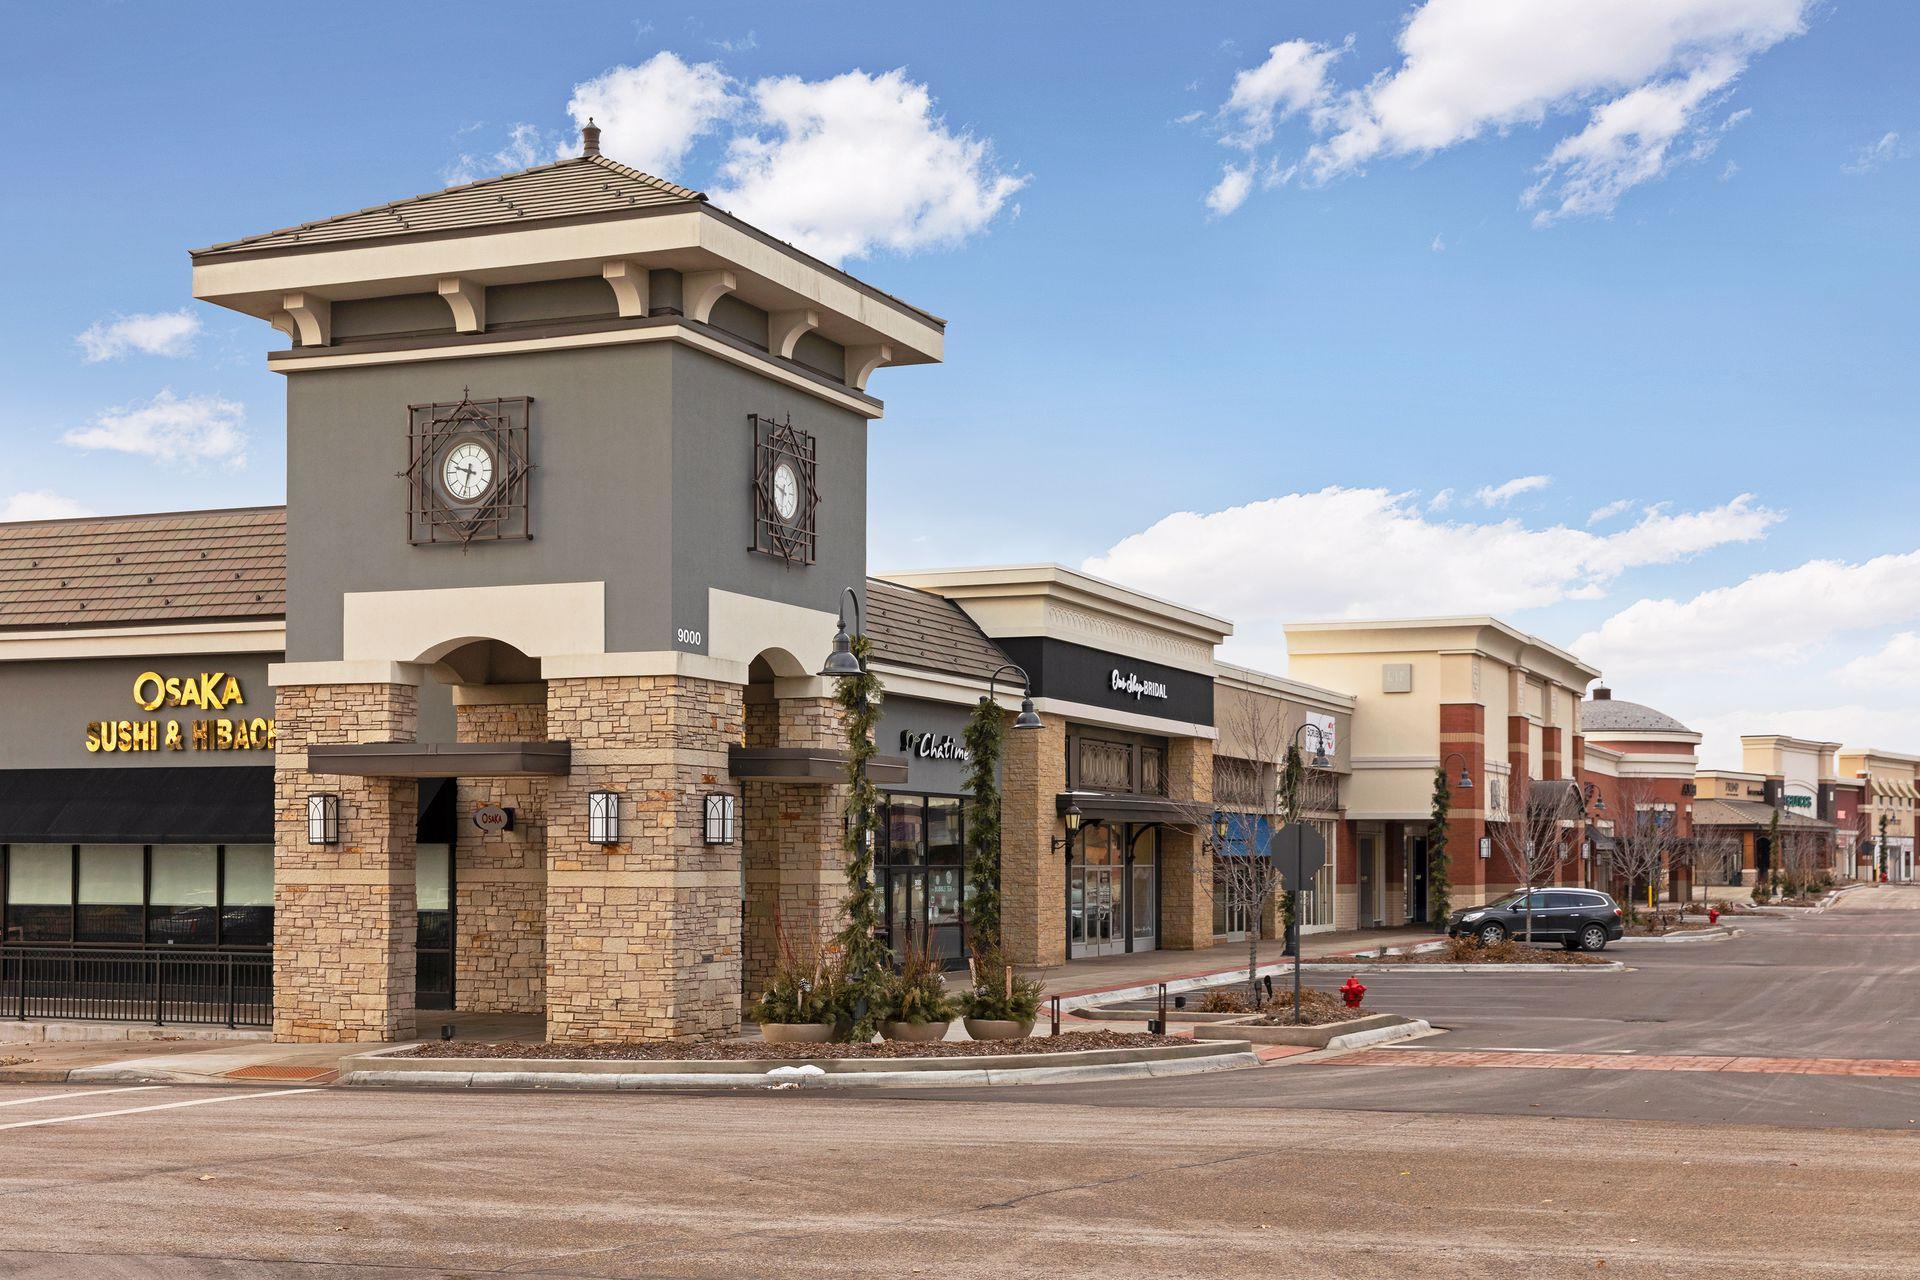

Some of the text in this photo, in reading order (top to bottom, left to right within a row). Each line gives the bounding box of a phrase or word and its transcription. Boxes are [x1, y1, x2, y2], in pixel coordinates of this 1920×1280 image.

[677, 628, 701, 646] 9000
[133, 671, 244, 712] OSAKA
[1143, 680, 1168, 699] BRIDAL
[86, 720, 158, 753] SUSHI
[165, 720, 184, 751] &
[919, 732, 970, 761] Chatime
